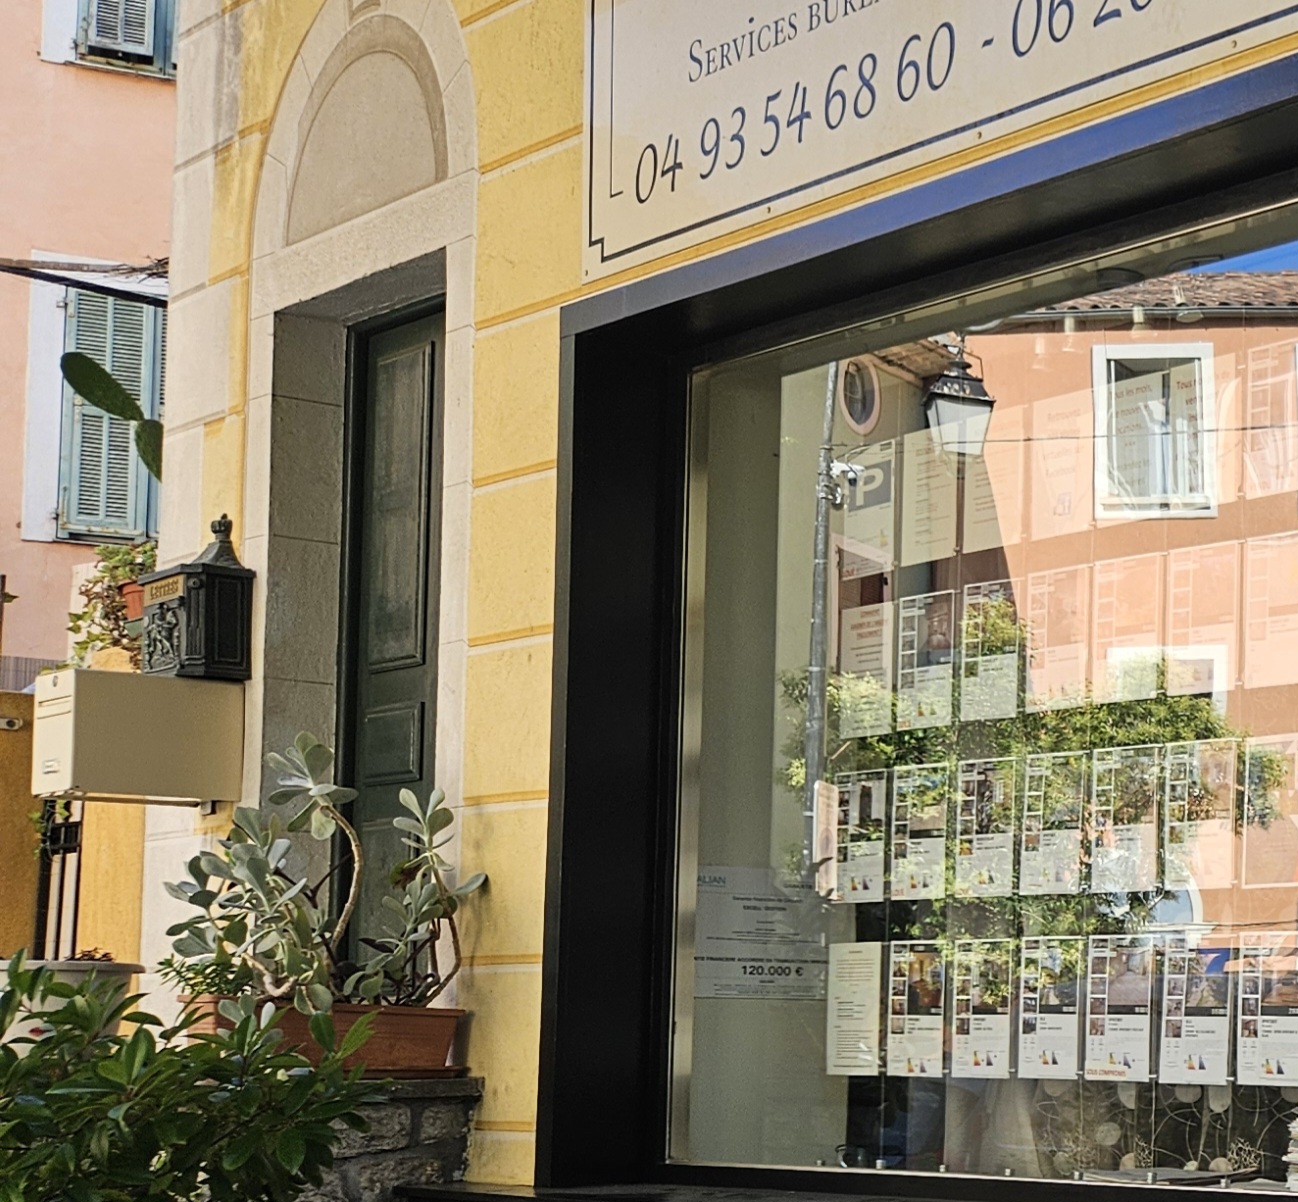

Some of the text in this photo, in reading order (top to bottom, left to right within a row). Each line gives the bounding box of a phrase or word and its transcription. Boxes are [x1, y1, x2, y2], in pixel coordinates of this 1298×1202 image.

[635, 133, 683, 204] 04
[699, 106, 746, 180] 93
[760, 81, 812, 156] 54
[824, 53, 877, 130] 68
[897, 22, 955, 102] 60
[741, 965, 791, 976] 120.000
